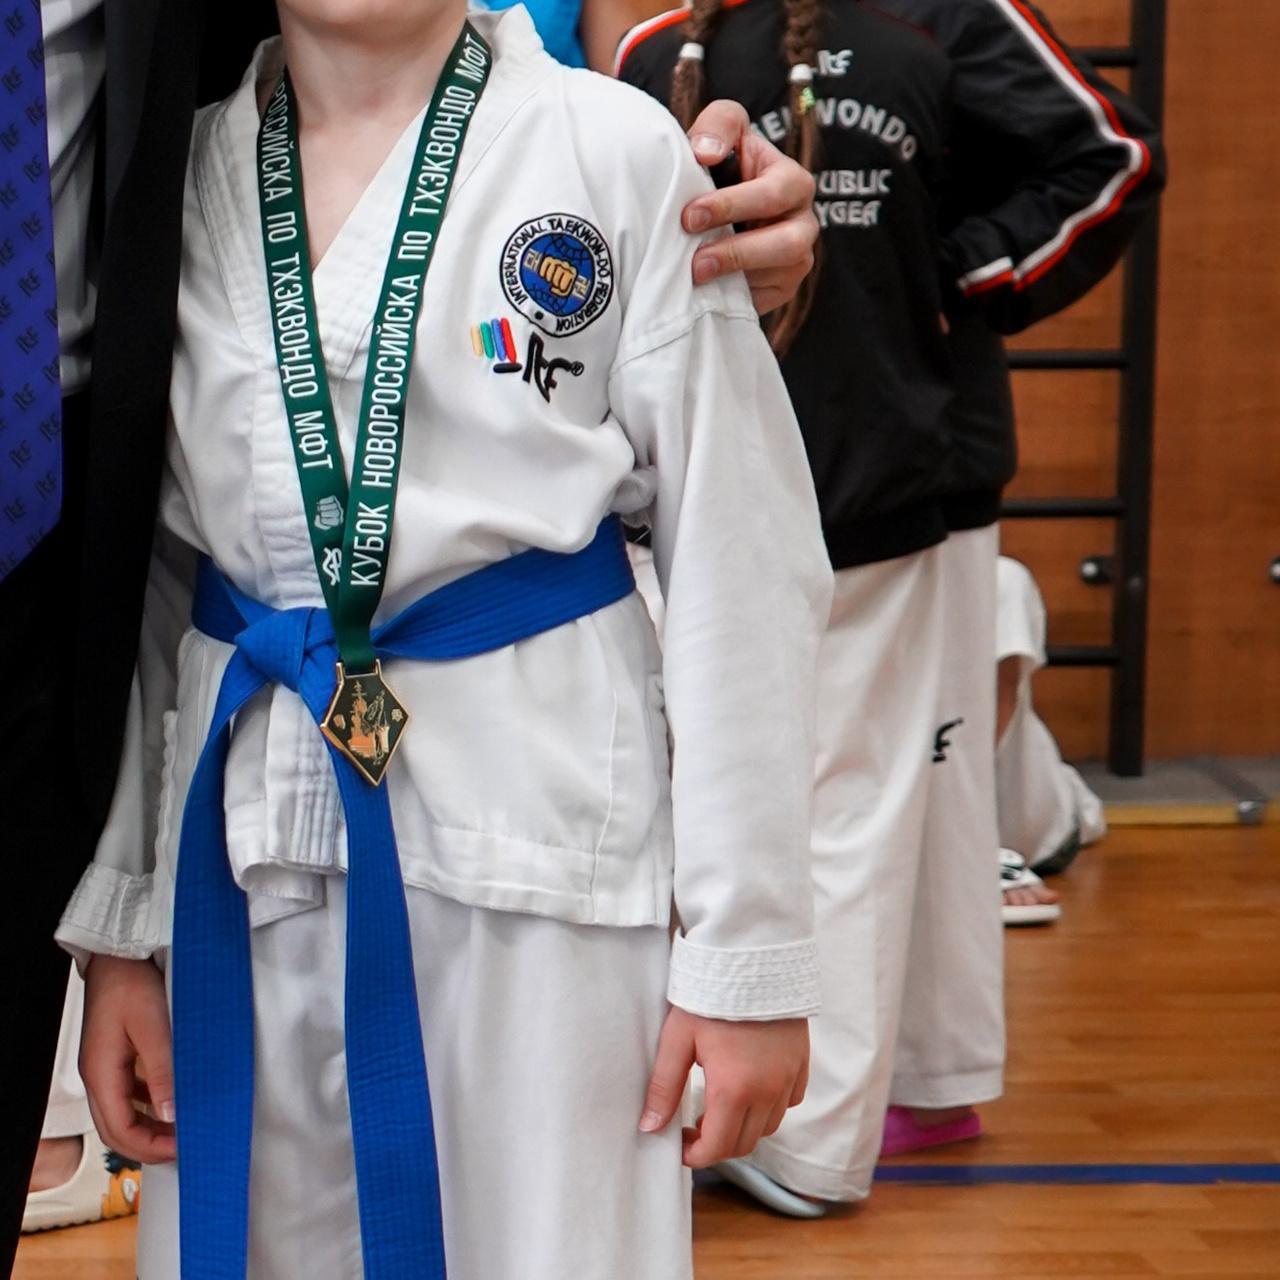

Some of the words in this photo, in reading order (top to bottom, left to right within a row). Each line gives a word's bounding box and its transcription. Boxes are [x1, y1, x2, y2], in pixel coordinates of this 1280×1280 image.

[454, 33, 489, 83] МФТ
[409, 85, 476, 217] ТХЭКВОНДО
[816, 169, 892, 195] UBLIC
[266, 211, 297, 243] ПО
[397, 230, 432, 261] ПО
[548, 218, 610, 278] TAEKWON-DO
[504, 222, 546, 305] INTERNATIONAL
[271, 251, 319, 398] ТХЭКВОНДО
[556, 281, 609, 331] FEDERATION
[361, 274, 422, 488] НОВОРОССИЙСКА
[293, 410, 333, 470] МФТ
[350, 502, 389, 586] КУБОК
